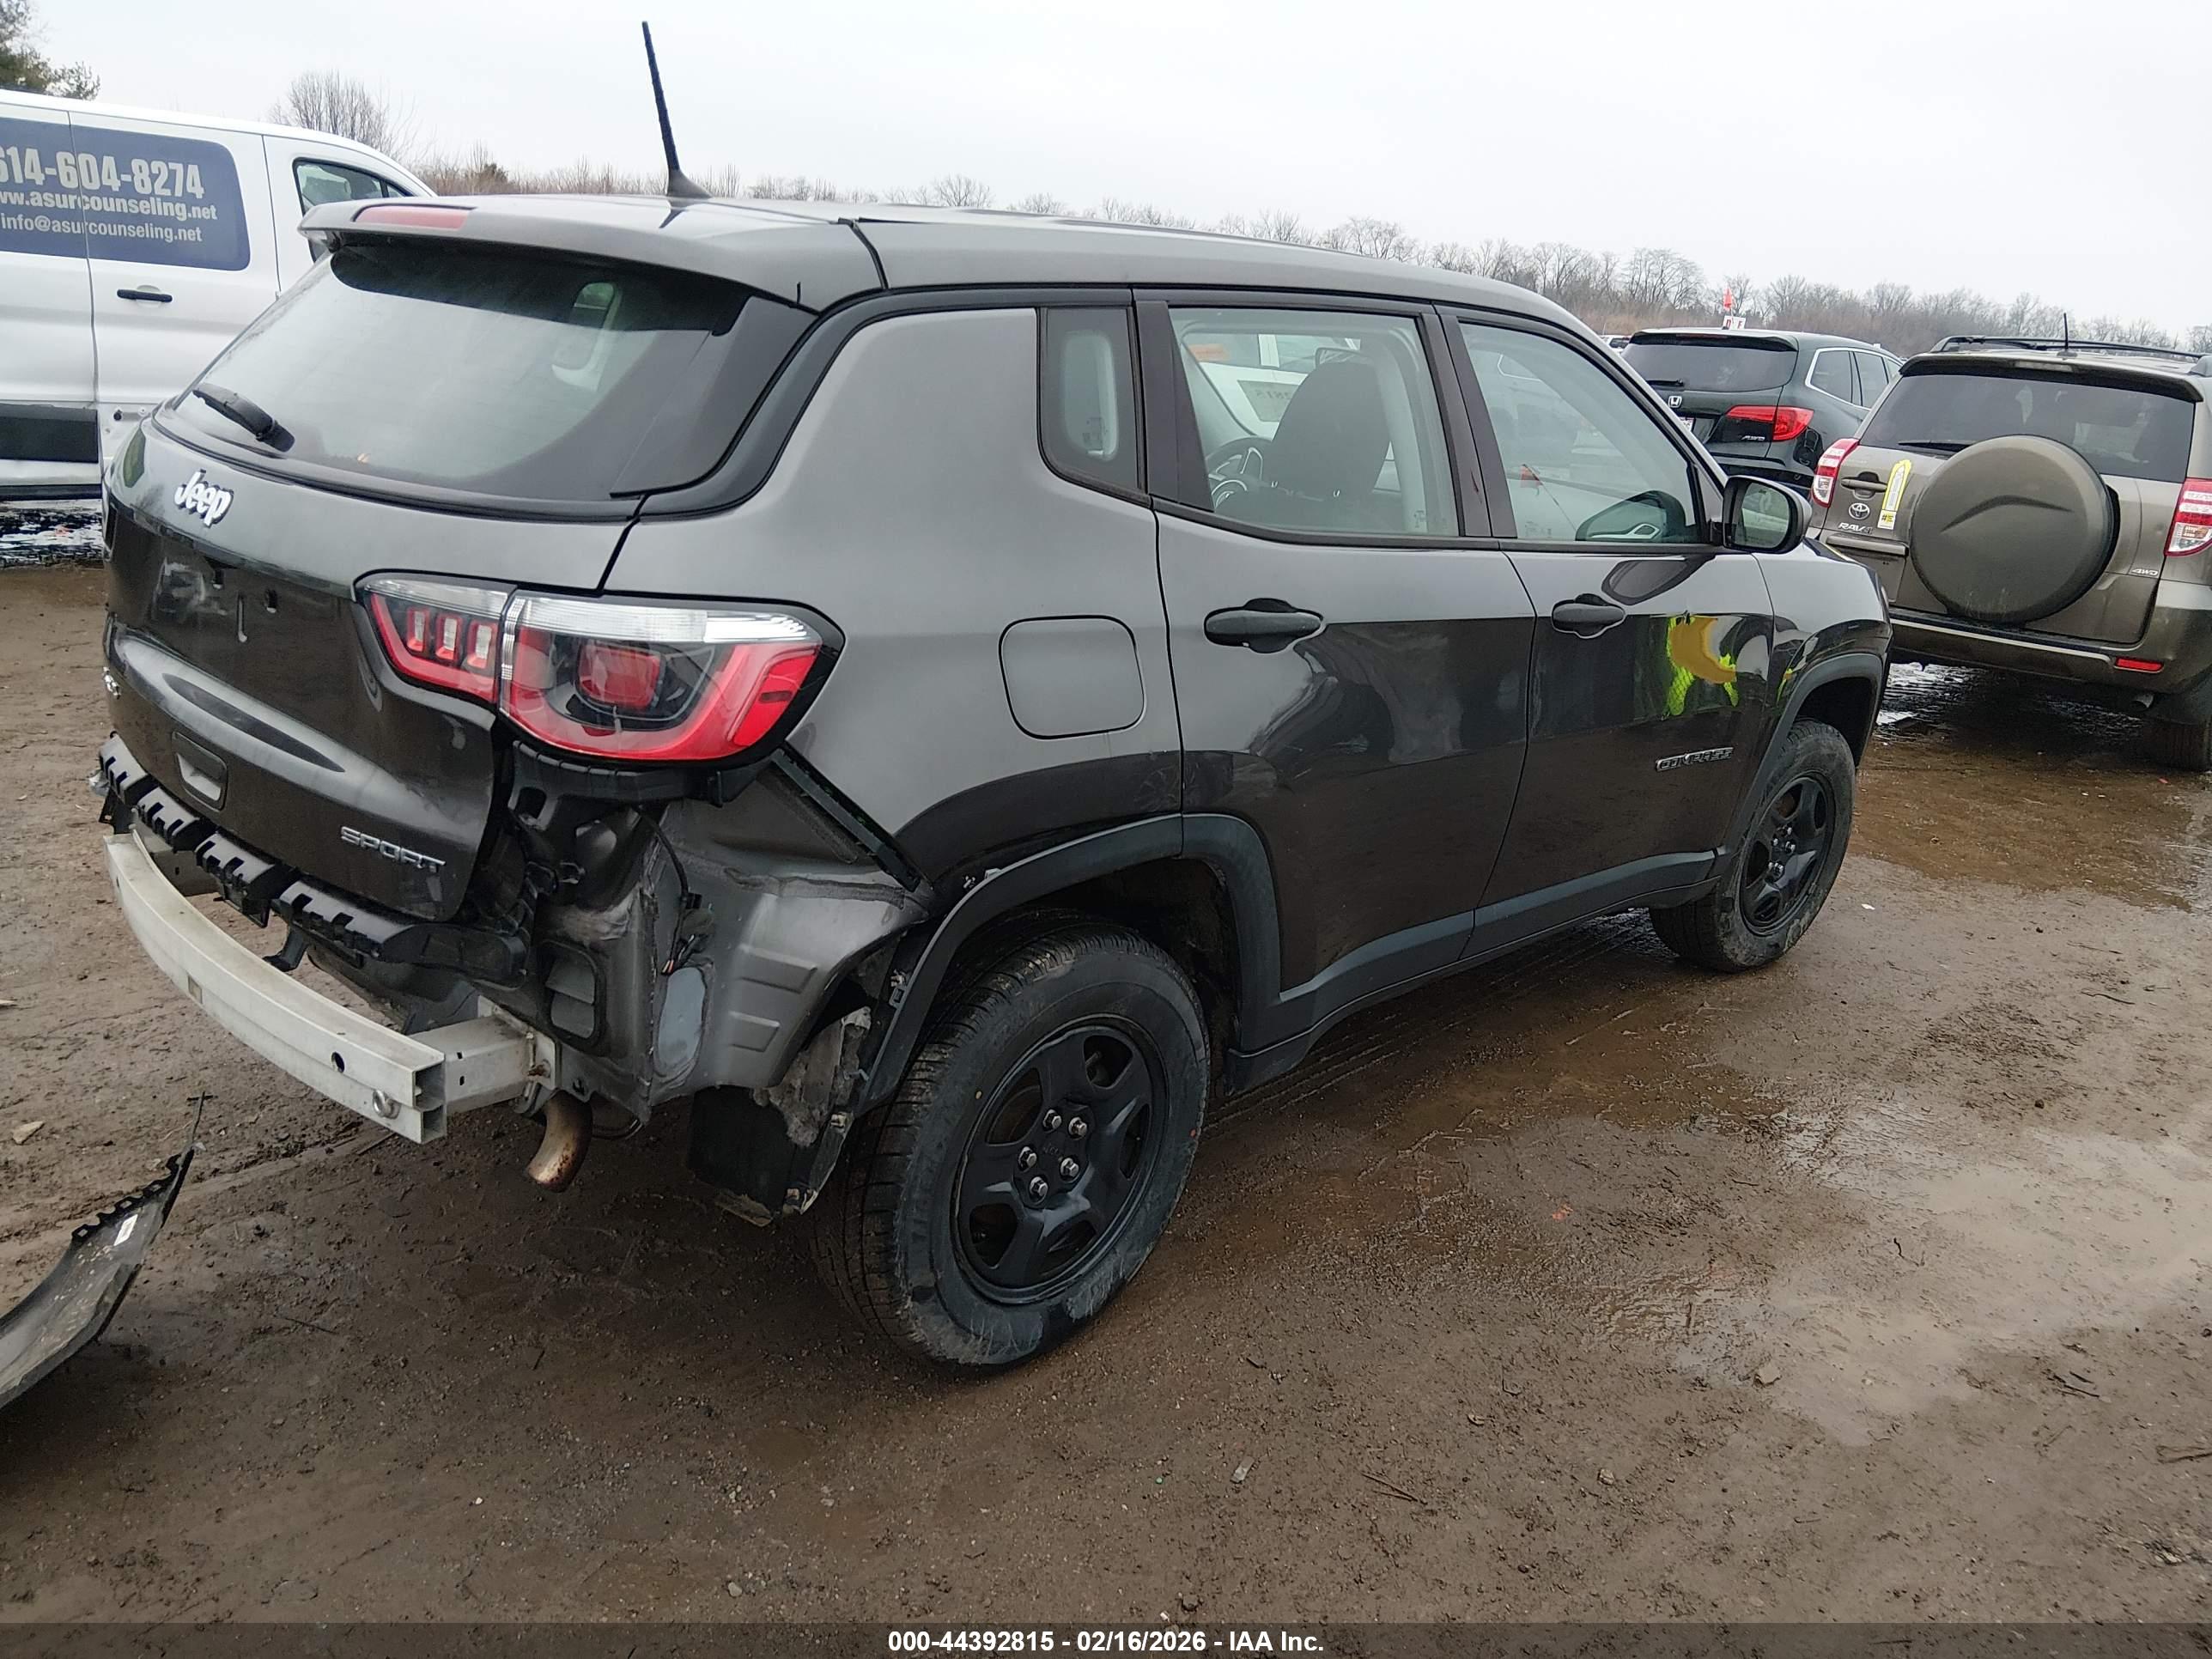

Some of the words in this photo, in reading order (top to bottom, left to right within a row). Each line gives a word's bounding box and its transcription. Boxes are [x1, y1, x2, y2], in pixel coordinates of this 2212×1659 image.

[0, 212, 203, 243] info@asurcounseling.net
[173, 470, 234, 527] Jeep
[1838, 522, 1873, 534] RAV4
[1656, 746, 1735, 772] COMPASS
[340, 826, 446, 873] SPORT
